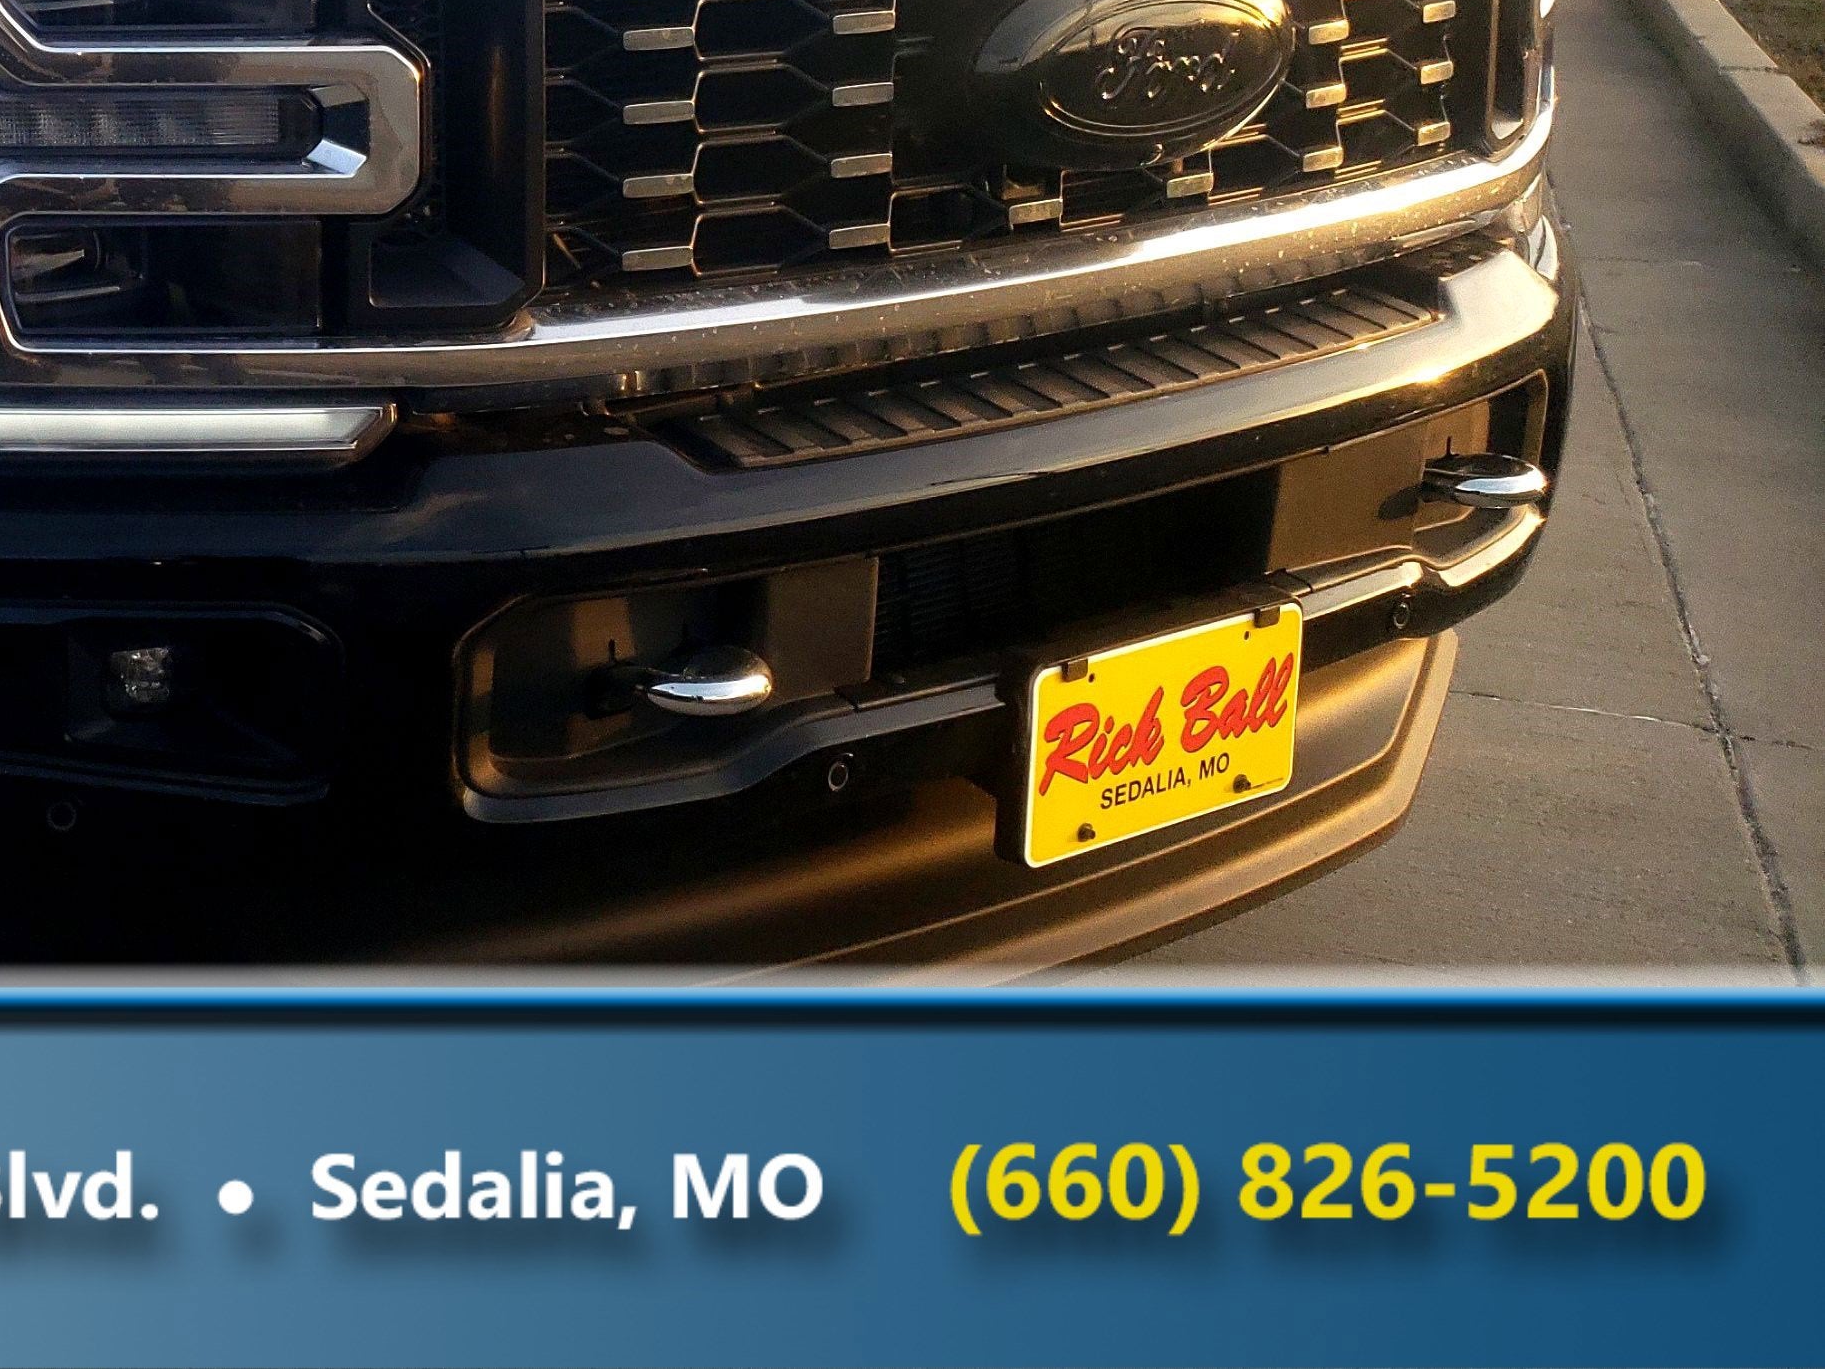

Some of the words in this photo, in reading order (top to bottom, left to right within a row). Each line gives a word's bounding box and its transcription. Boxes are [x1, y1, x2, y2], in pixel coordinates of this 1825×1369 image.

[1092, 29, 1239, 102] Ford
[1038, 686, 1165, 796] Rick
[1180, 653, 1294, 753] Ball
[1100, 768, 1192, 810] SEDALIA,
[1198, 752, 1230, 779] MO
